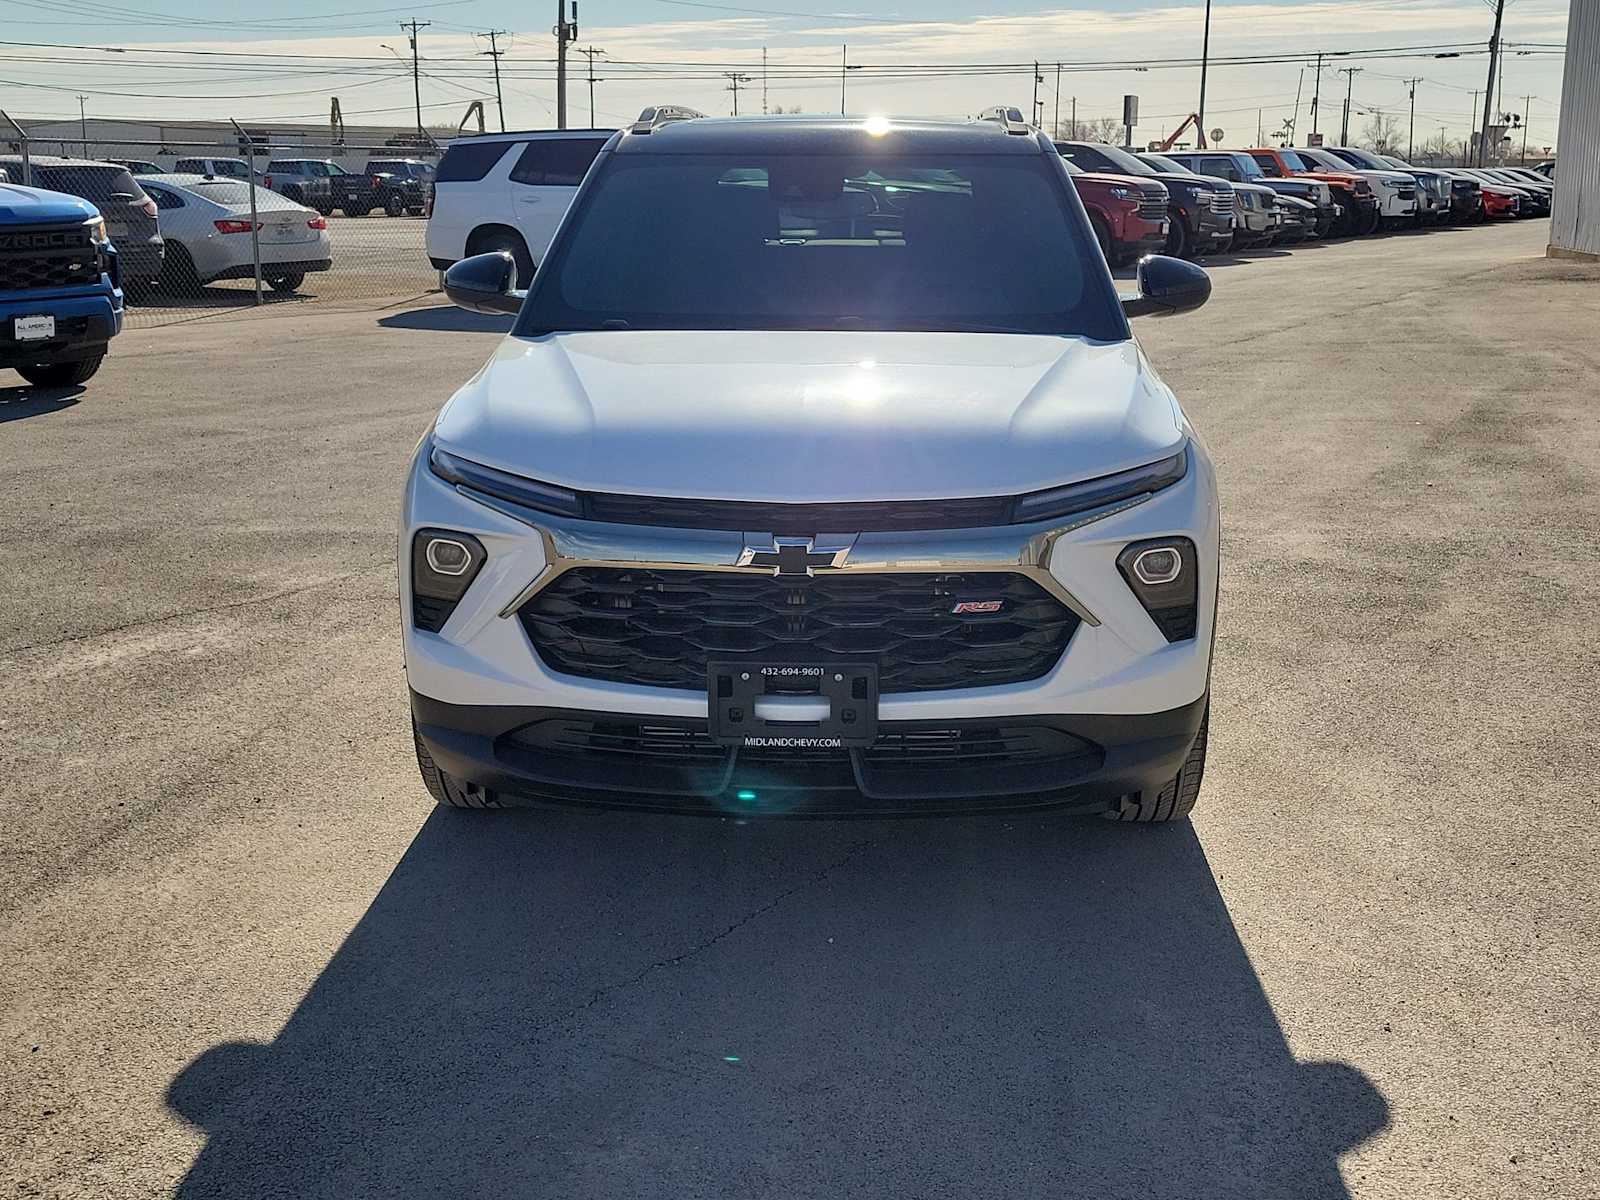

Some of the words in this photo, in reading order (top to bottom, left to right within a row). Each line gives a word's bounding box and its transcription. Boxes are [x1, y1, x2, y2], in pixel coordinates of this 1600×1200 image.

[952, 600, 1003, 614] RS
[760, 667, 825, 676] 432-694-9601
[744, 737, 841, 747] MIDLANDCHEVY.COM
